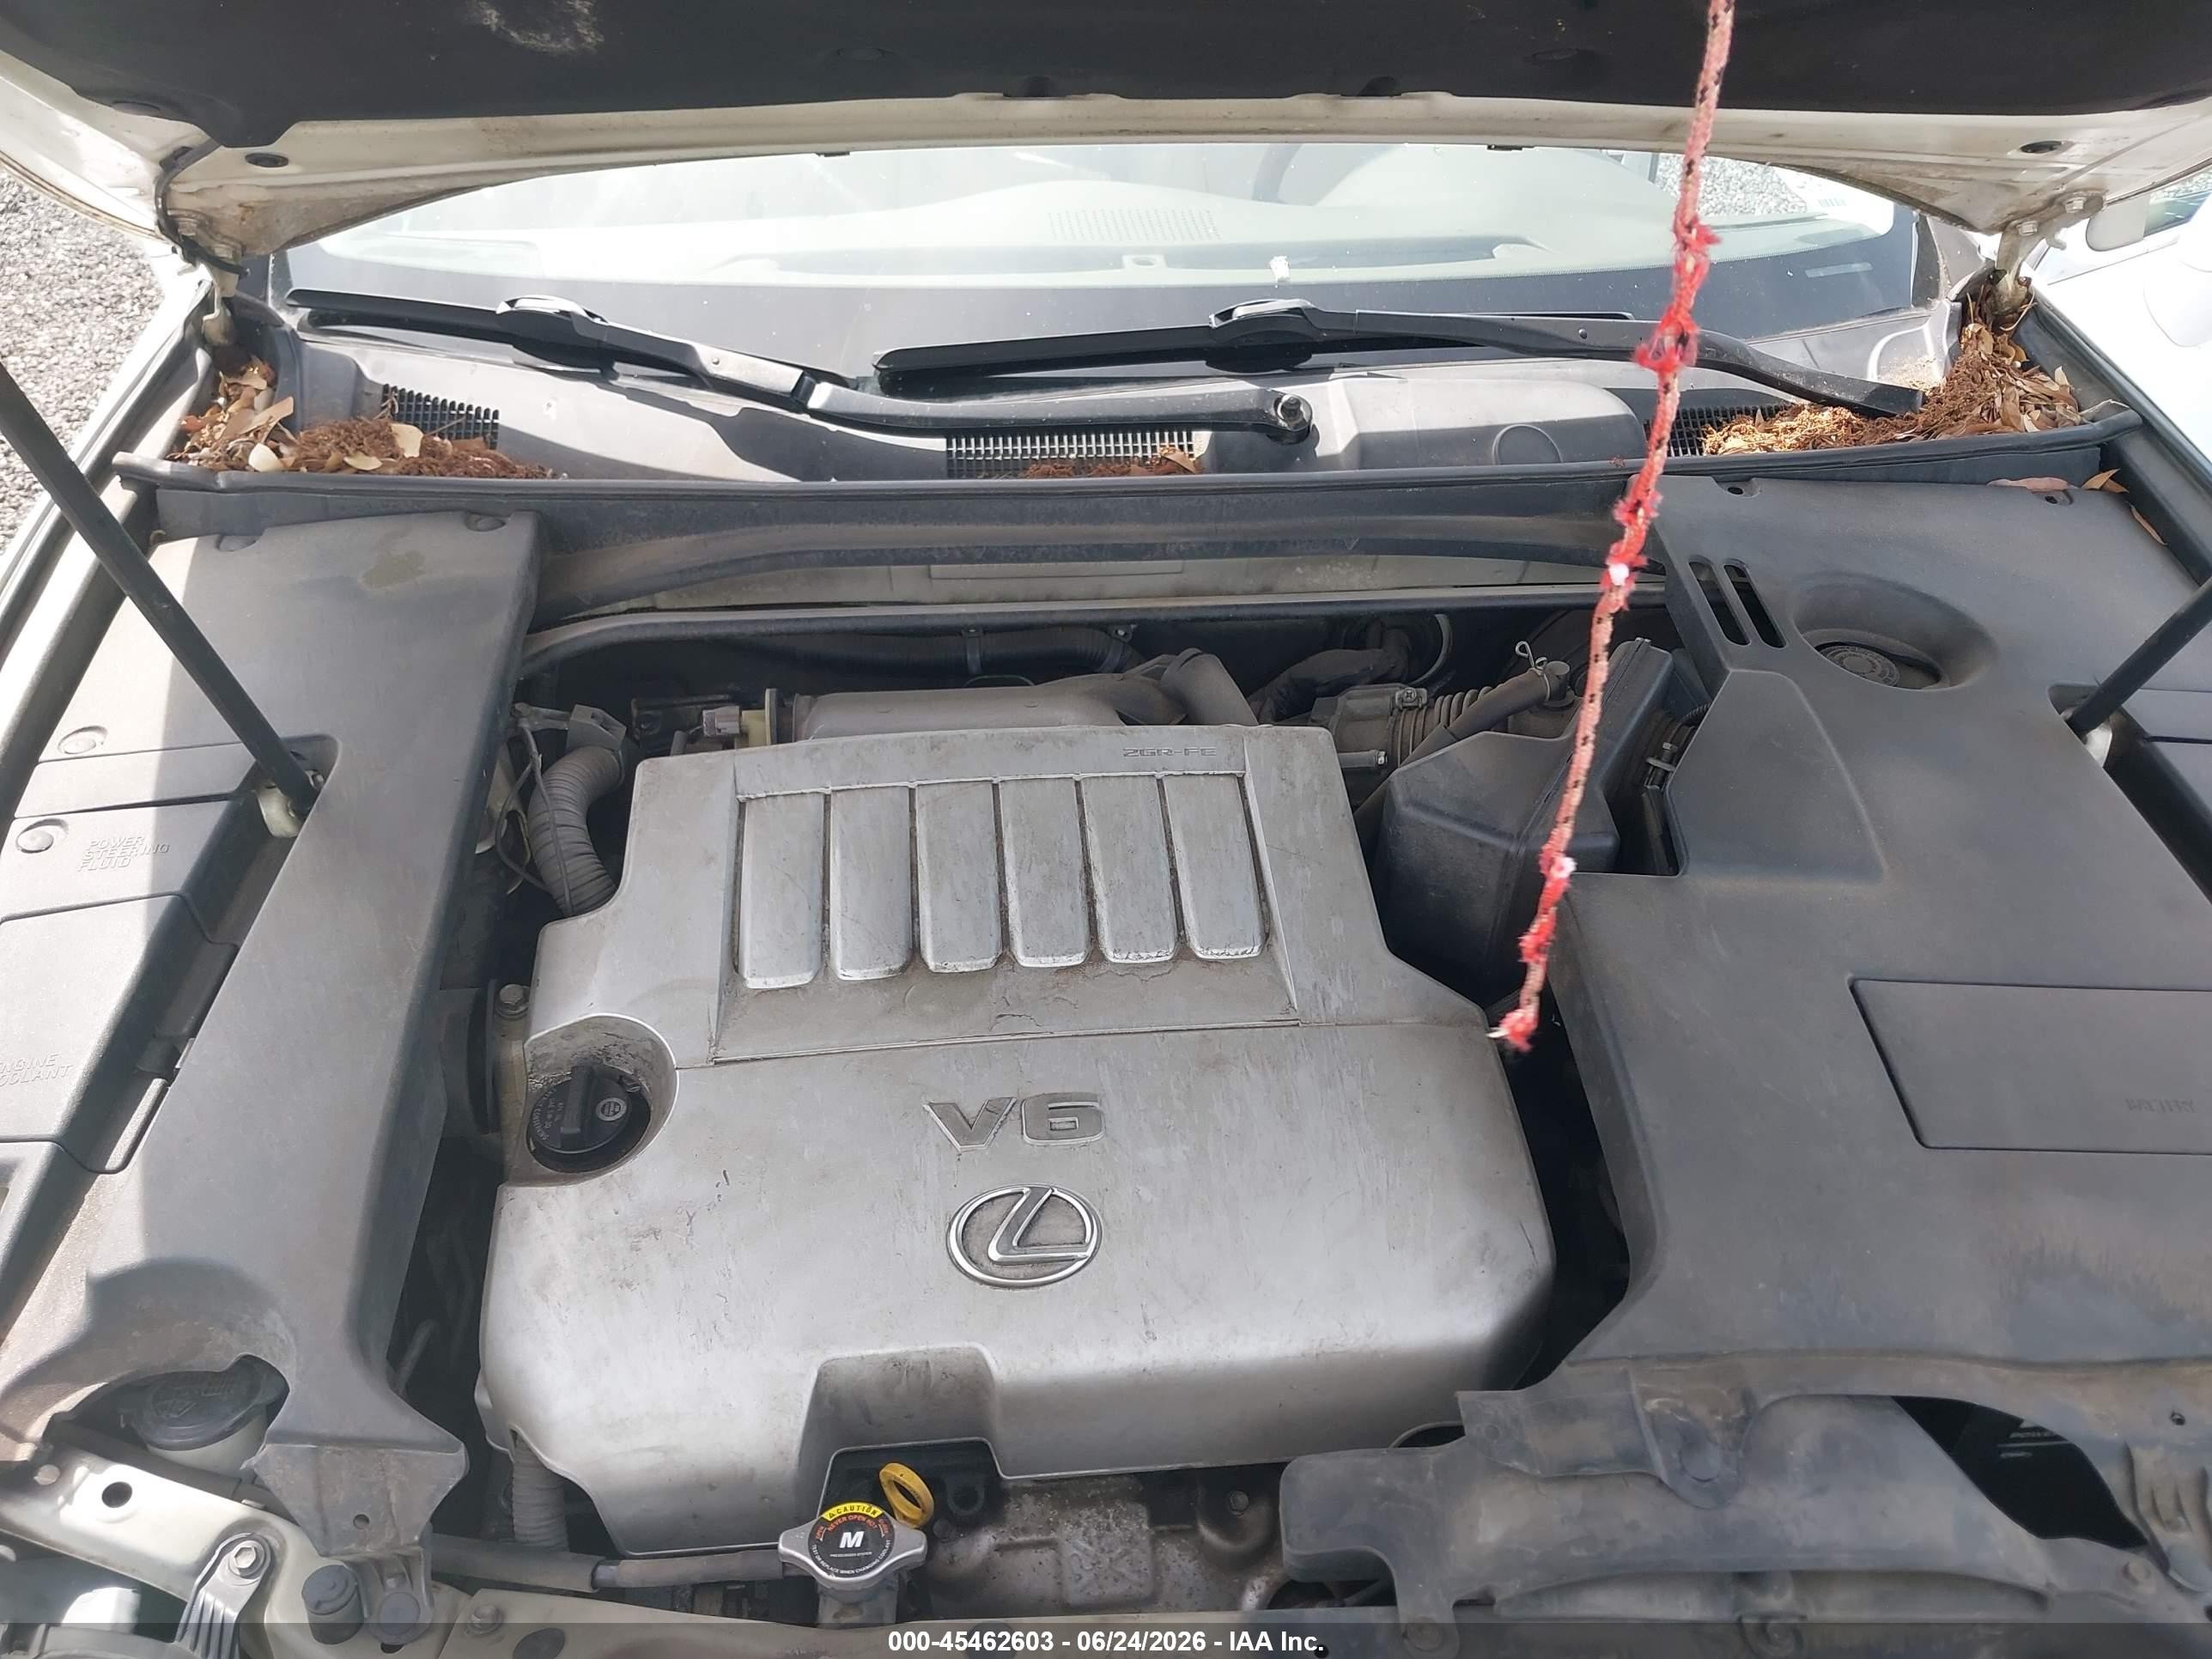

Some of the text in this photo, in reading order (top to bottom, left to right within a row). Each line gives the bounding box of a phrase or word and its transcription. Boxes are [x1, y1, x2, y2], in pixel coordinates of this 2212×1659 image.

[1122, 748, 1217, 757] 2GR-FE
[87, 836, 145, 851] POWER
[77, 857, 131, 872] FLUID
[922, 1091, 1106, 1154] V6
[836, 1504, 878, 1516] CAUTION
[839, 1531, 865, 1549] M
[819, 1560, 839, 1573] REPLACE
